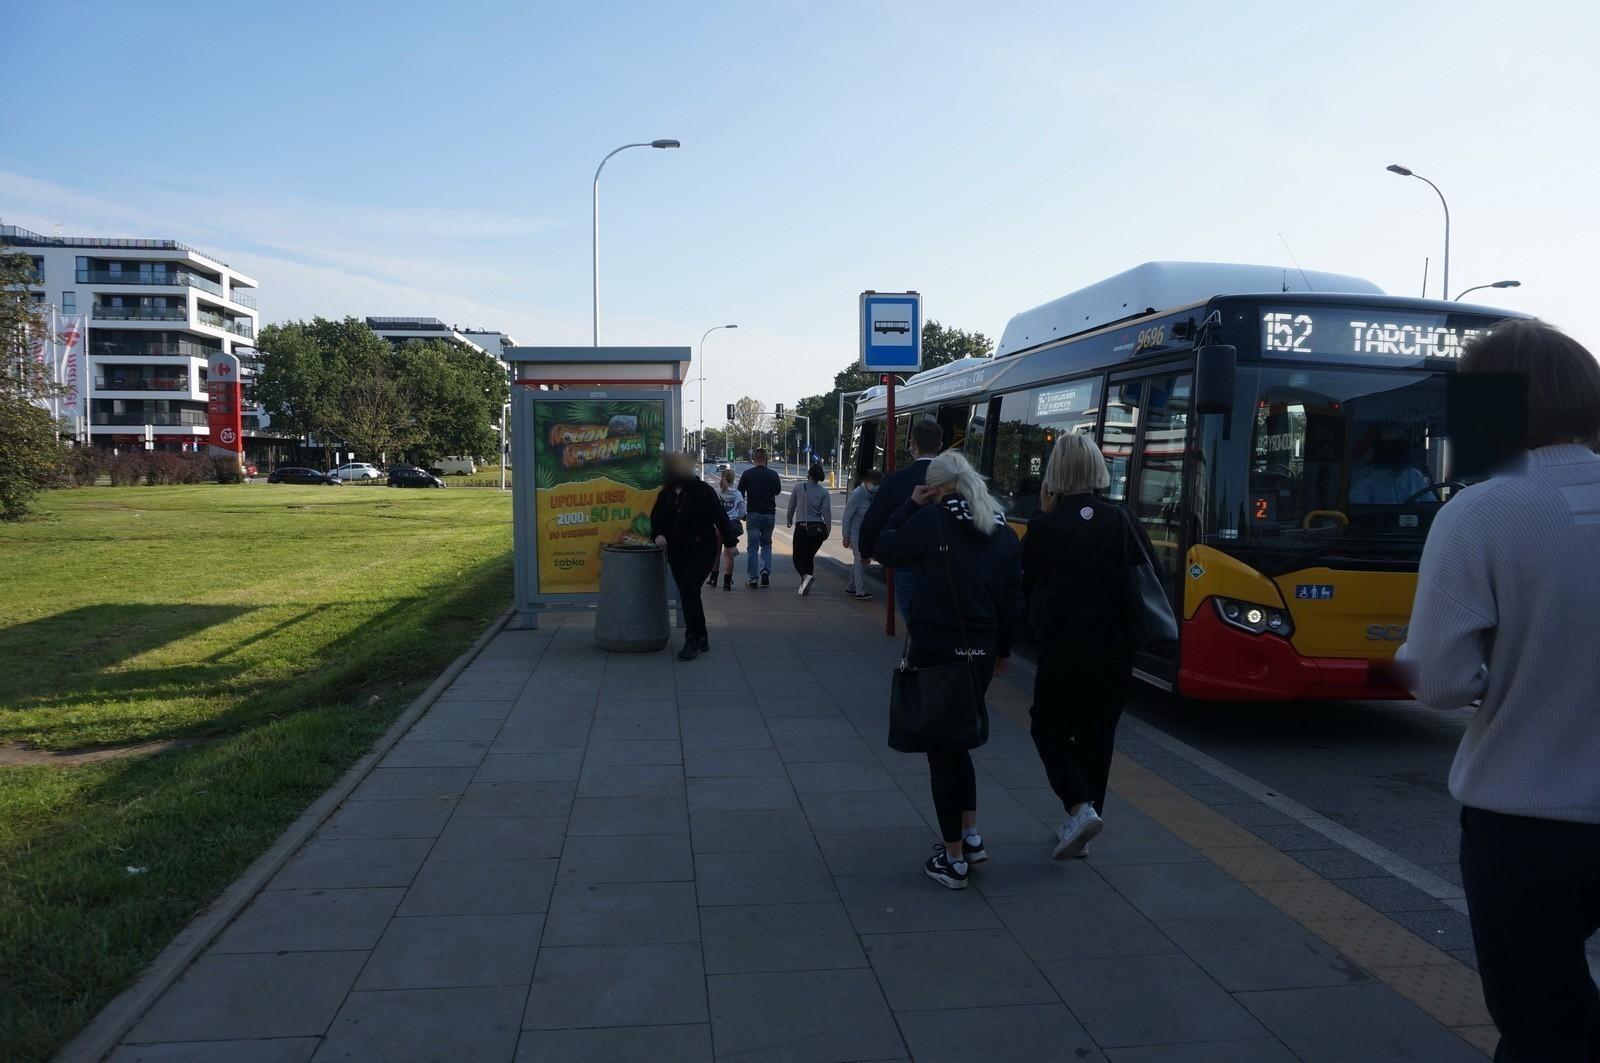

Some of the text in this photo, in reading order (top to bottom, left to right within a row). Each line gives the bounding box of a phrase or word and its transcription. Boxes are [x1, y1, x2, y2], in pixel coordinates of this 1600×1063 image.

[1137, 325, 1165, 350] 9696
[1263, 313, 1491, 359] 152 TARCHOM
[223, 431, 233, 440] 24
[550, 492, 593, 509] UPOLUJ
[1256, 498, 1268, 519] 2
[556, 512, 585, 526] 2000
[591, 506, 609, 522] 50
[611, 507, 632, 521] PLN
[553, 557, 586, 568] żabka
